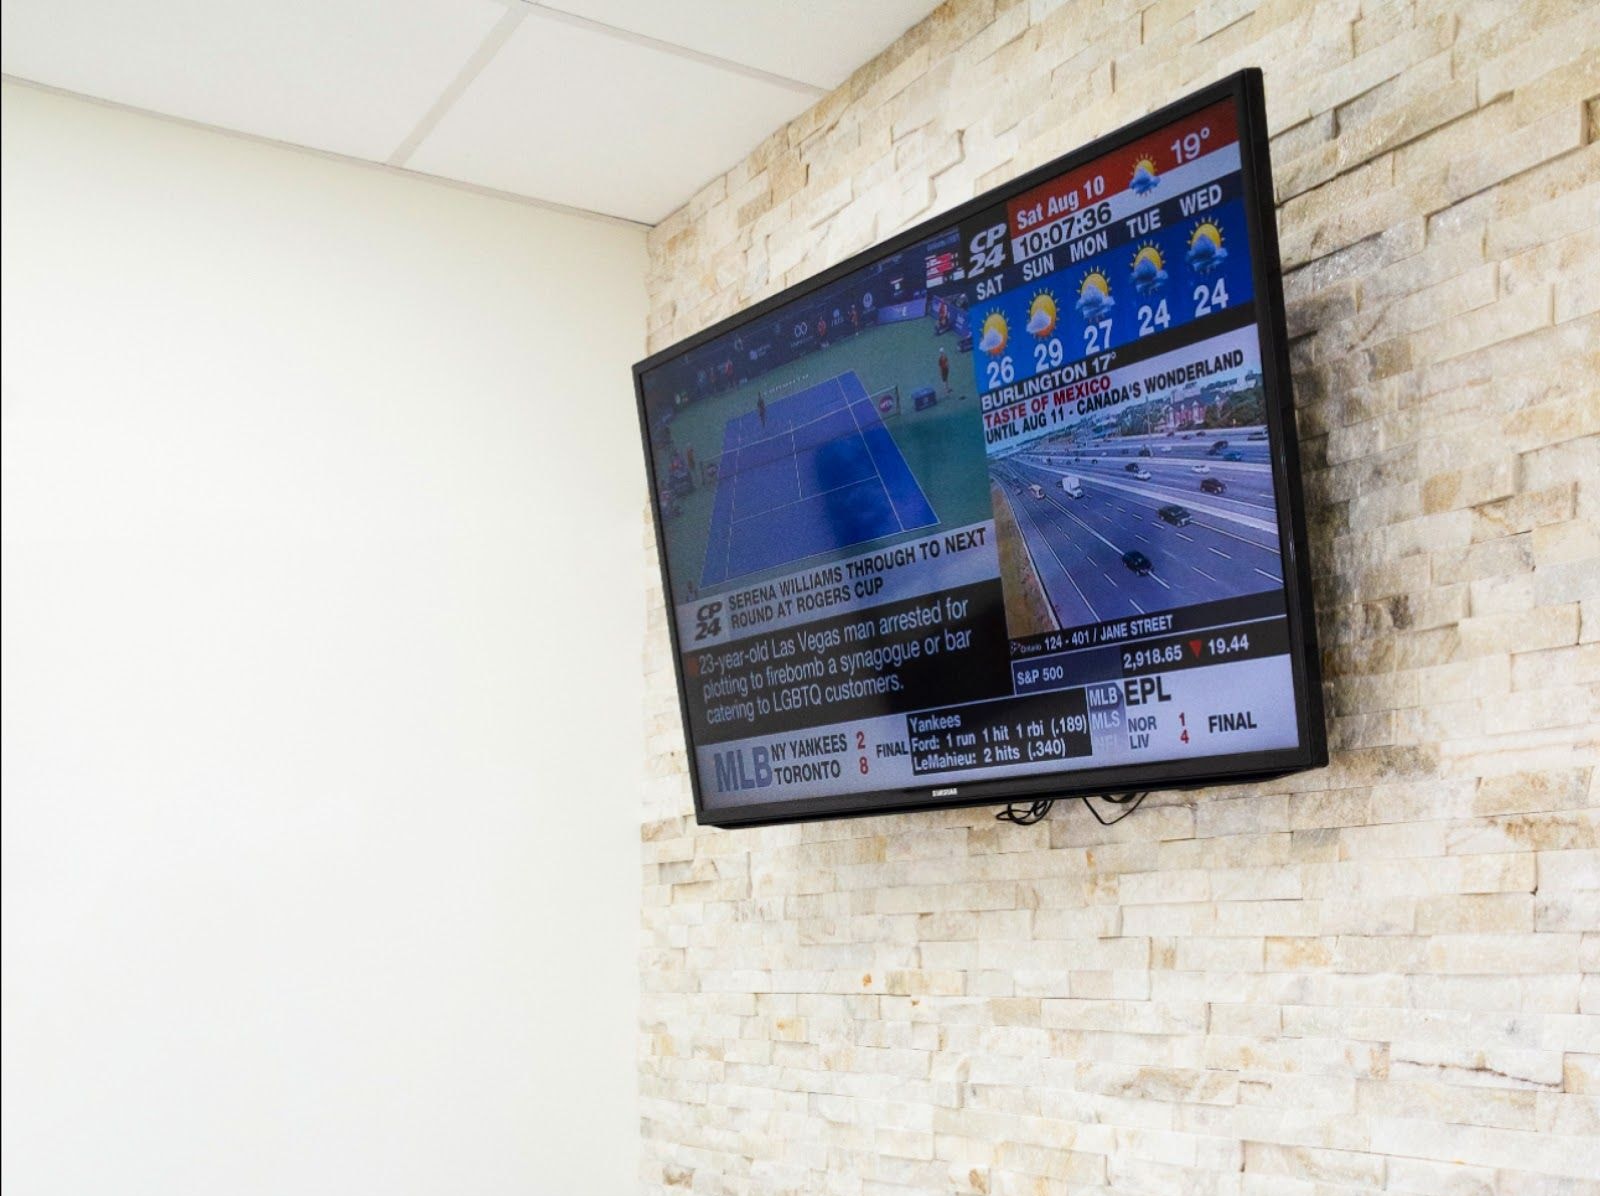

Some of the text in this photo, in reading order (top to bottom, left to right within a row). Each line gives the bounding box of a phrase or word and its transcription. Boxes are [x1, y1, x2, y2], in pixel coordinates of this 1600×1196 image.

[1017, 175, 1105, 230] Sat Aug 10
[969, 223, 1007, 254] CP
[976, 184, 1222, 301] SAT SUN MON TUE WED
[1019, 201, 1112, 258] 10:07:36
[967, 243, 1006, 279] 24
[986, 277, 1229, 389] 26 29 27 24 24
[981, 361, 1088, 411] BURLINGTON
[984, 375, 1111, 429] TASTE OF MEXICO
[986, 423, 1019, 445] UNTIL
[1023, 412, 1046, 433] AUG
[1050, 406, 1064, 424] 11
[1077, 383, 1141, 416] CANADA'S
[1144, 349, 1244, 394] WONDERLAND
[728, 527, 986, 610] SERENA WILLIAMS THROUGH TO NEXT
[697, 601, 722, 621] CP
[731, 577, 883, 629] ROUND AT ROGERS CUP
[695, 618, 721, 640] 24
[699, 597, 969, 675] 23-year-old Las Vegas man arrested for
[1044, 634, 1063, 651] 124
[1071, 629, 1089, 646] 401
[1100, 624, 1128, 641] JANE
[1130, 614, 1173, 635] STREET
[703, 628, 972, 703] plotting to firebomb a synagogue or bar
[1017, 634, 1249, 686] S&P 500 2,918.65 19.44
[707, 674, 904, 724] catering to LGBTQ customers.
[1089, 687, 1118, 707] MLB
[1124, 676, 1172, 706] EPL
[909, 713, 962, 734] Yankees
[911, 714, 1088, 753] Ford: 1 run 1 hit 1 rbi (.189)
[1091, 710, 1120, 730] MLS
[1127, 712, 1186, 733] NOR 1
[1208, 711, 1257, 733] FINAL
[771, 731, 866, 762] NY YANKEES 2
[876, 740, 910, 759] FINAL
[913, 738, 1066, 772] LeMahieu: 2 hits (.340)
[1130, 730, 1190, 749] LIV 4
[713, 745, 773, 793] MLB
[774, 756, 869, 786] TORONTO 8
